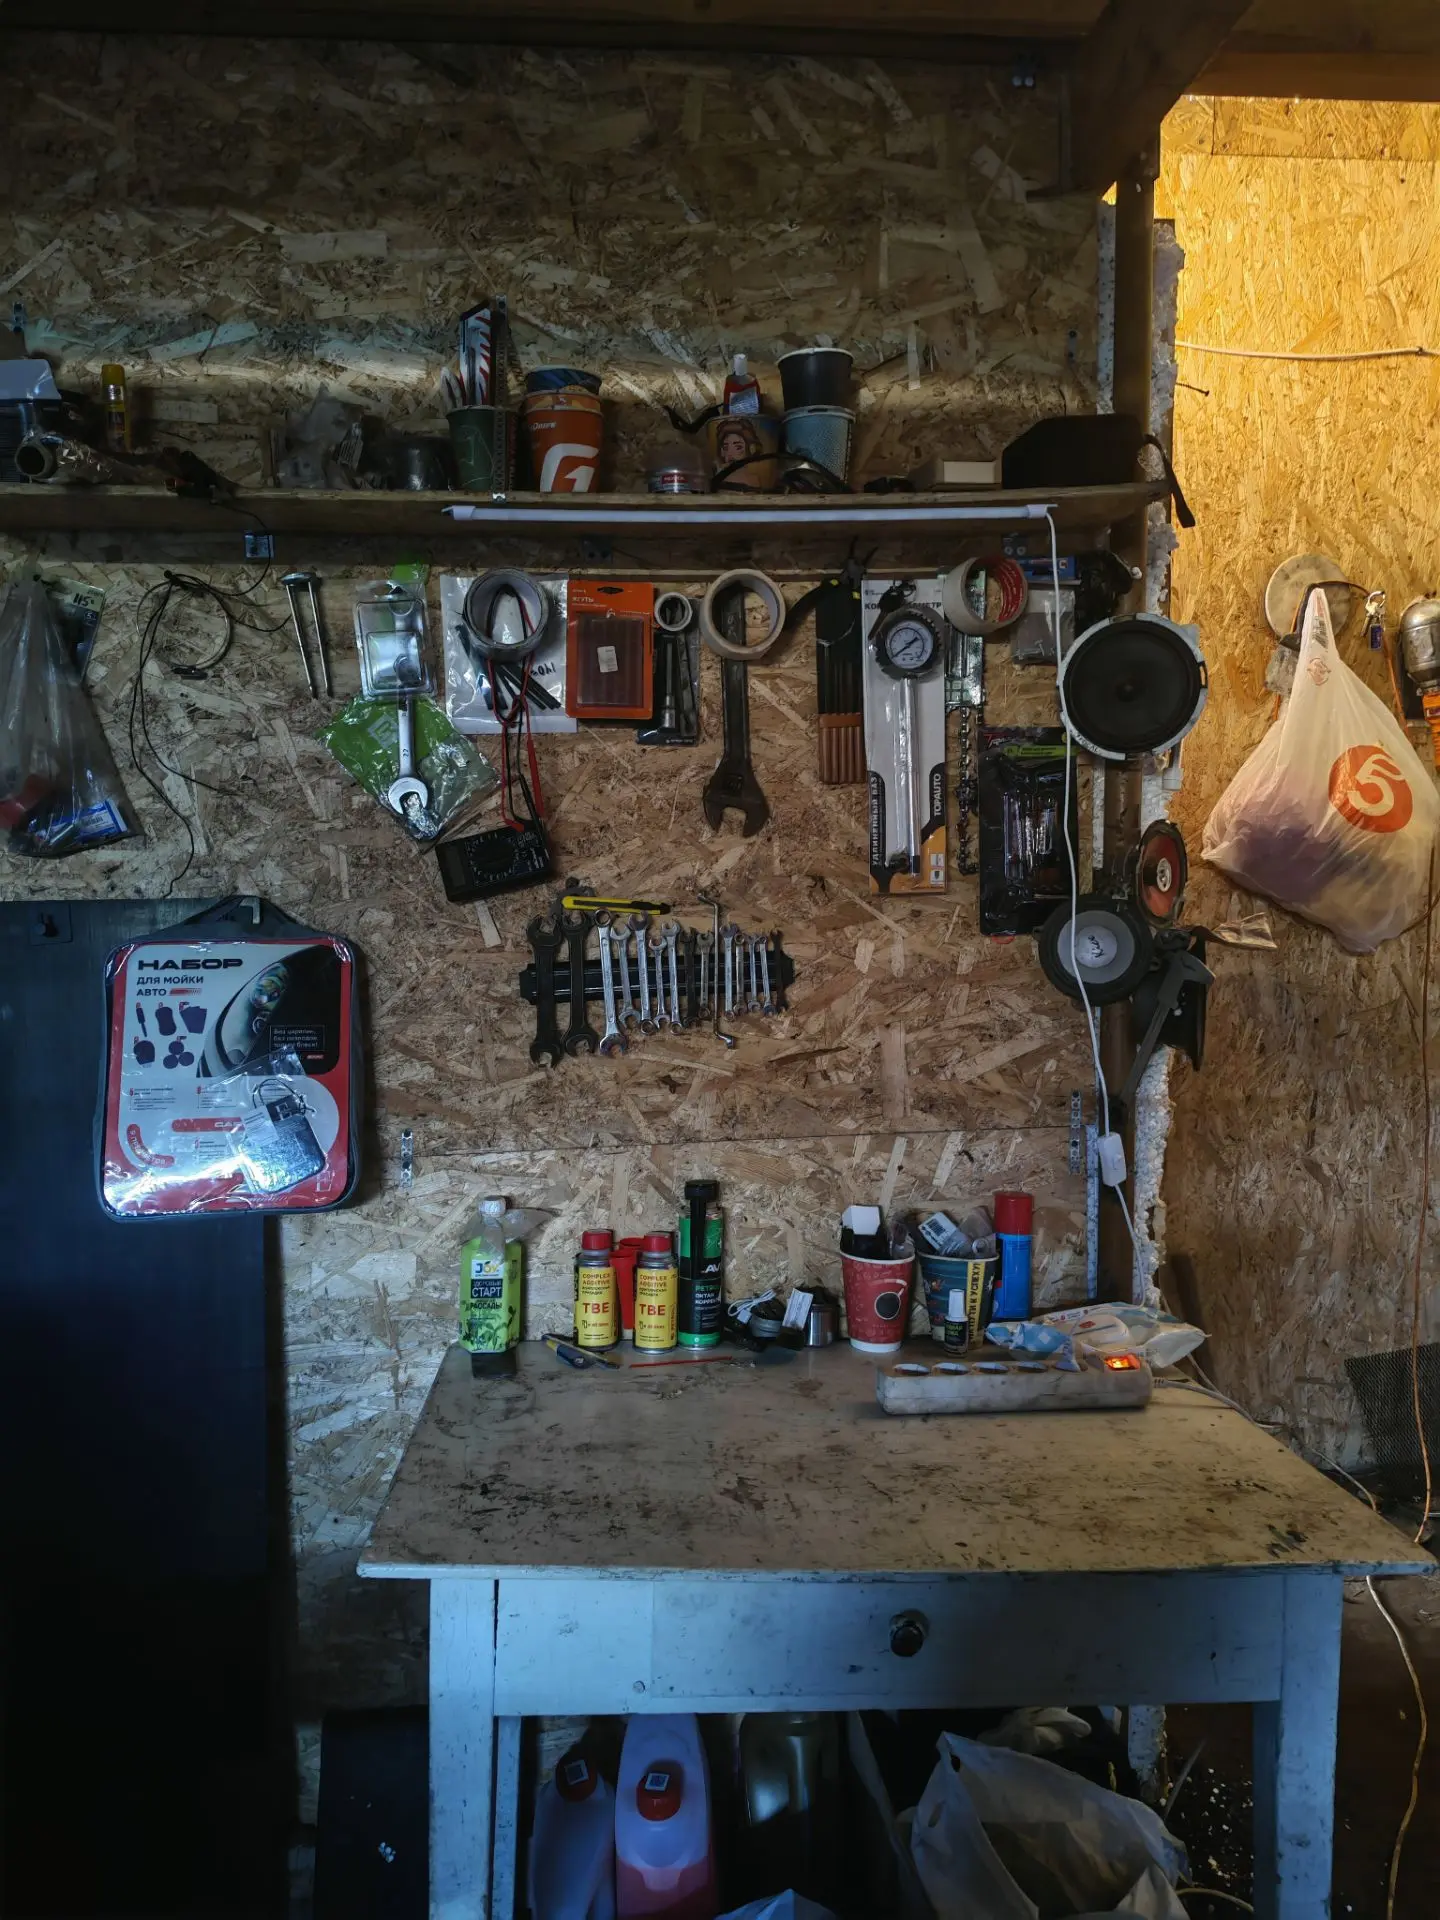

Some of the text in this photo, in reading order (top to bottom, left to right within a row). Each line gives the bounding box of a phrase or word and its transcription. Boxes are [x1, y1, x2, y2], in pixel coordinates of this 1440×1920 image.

[933, 773, 942, 817] TOPAUTO
[138, 958, 244, 971] НАБОР
[136, 975, 204, 985] ДЛЯ МОЙКИ
[136, 988, 167, 996] АВТО
[472, 1287, 502, 1298] СТАРТ
